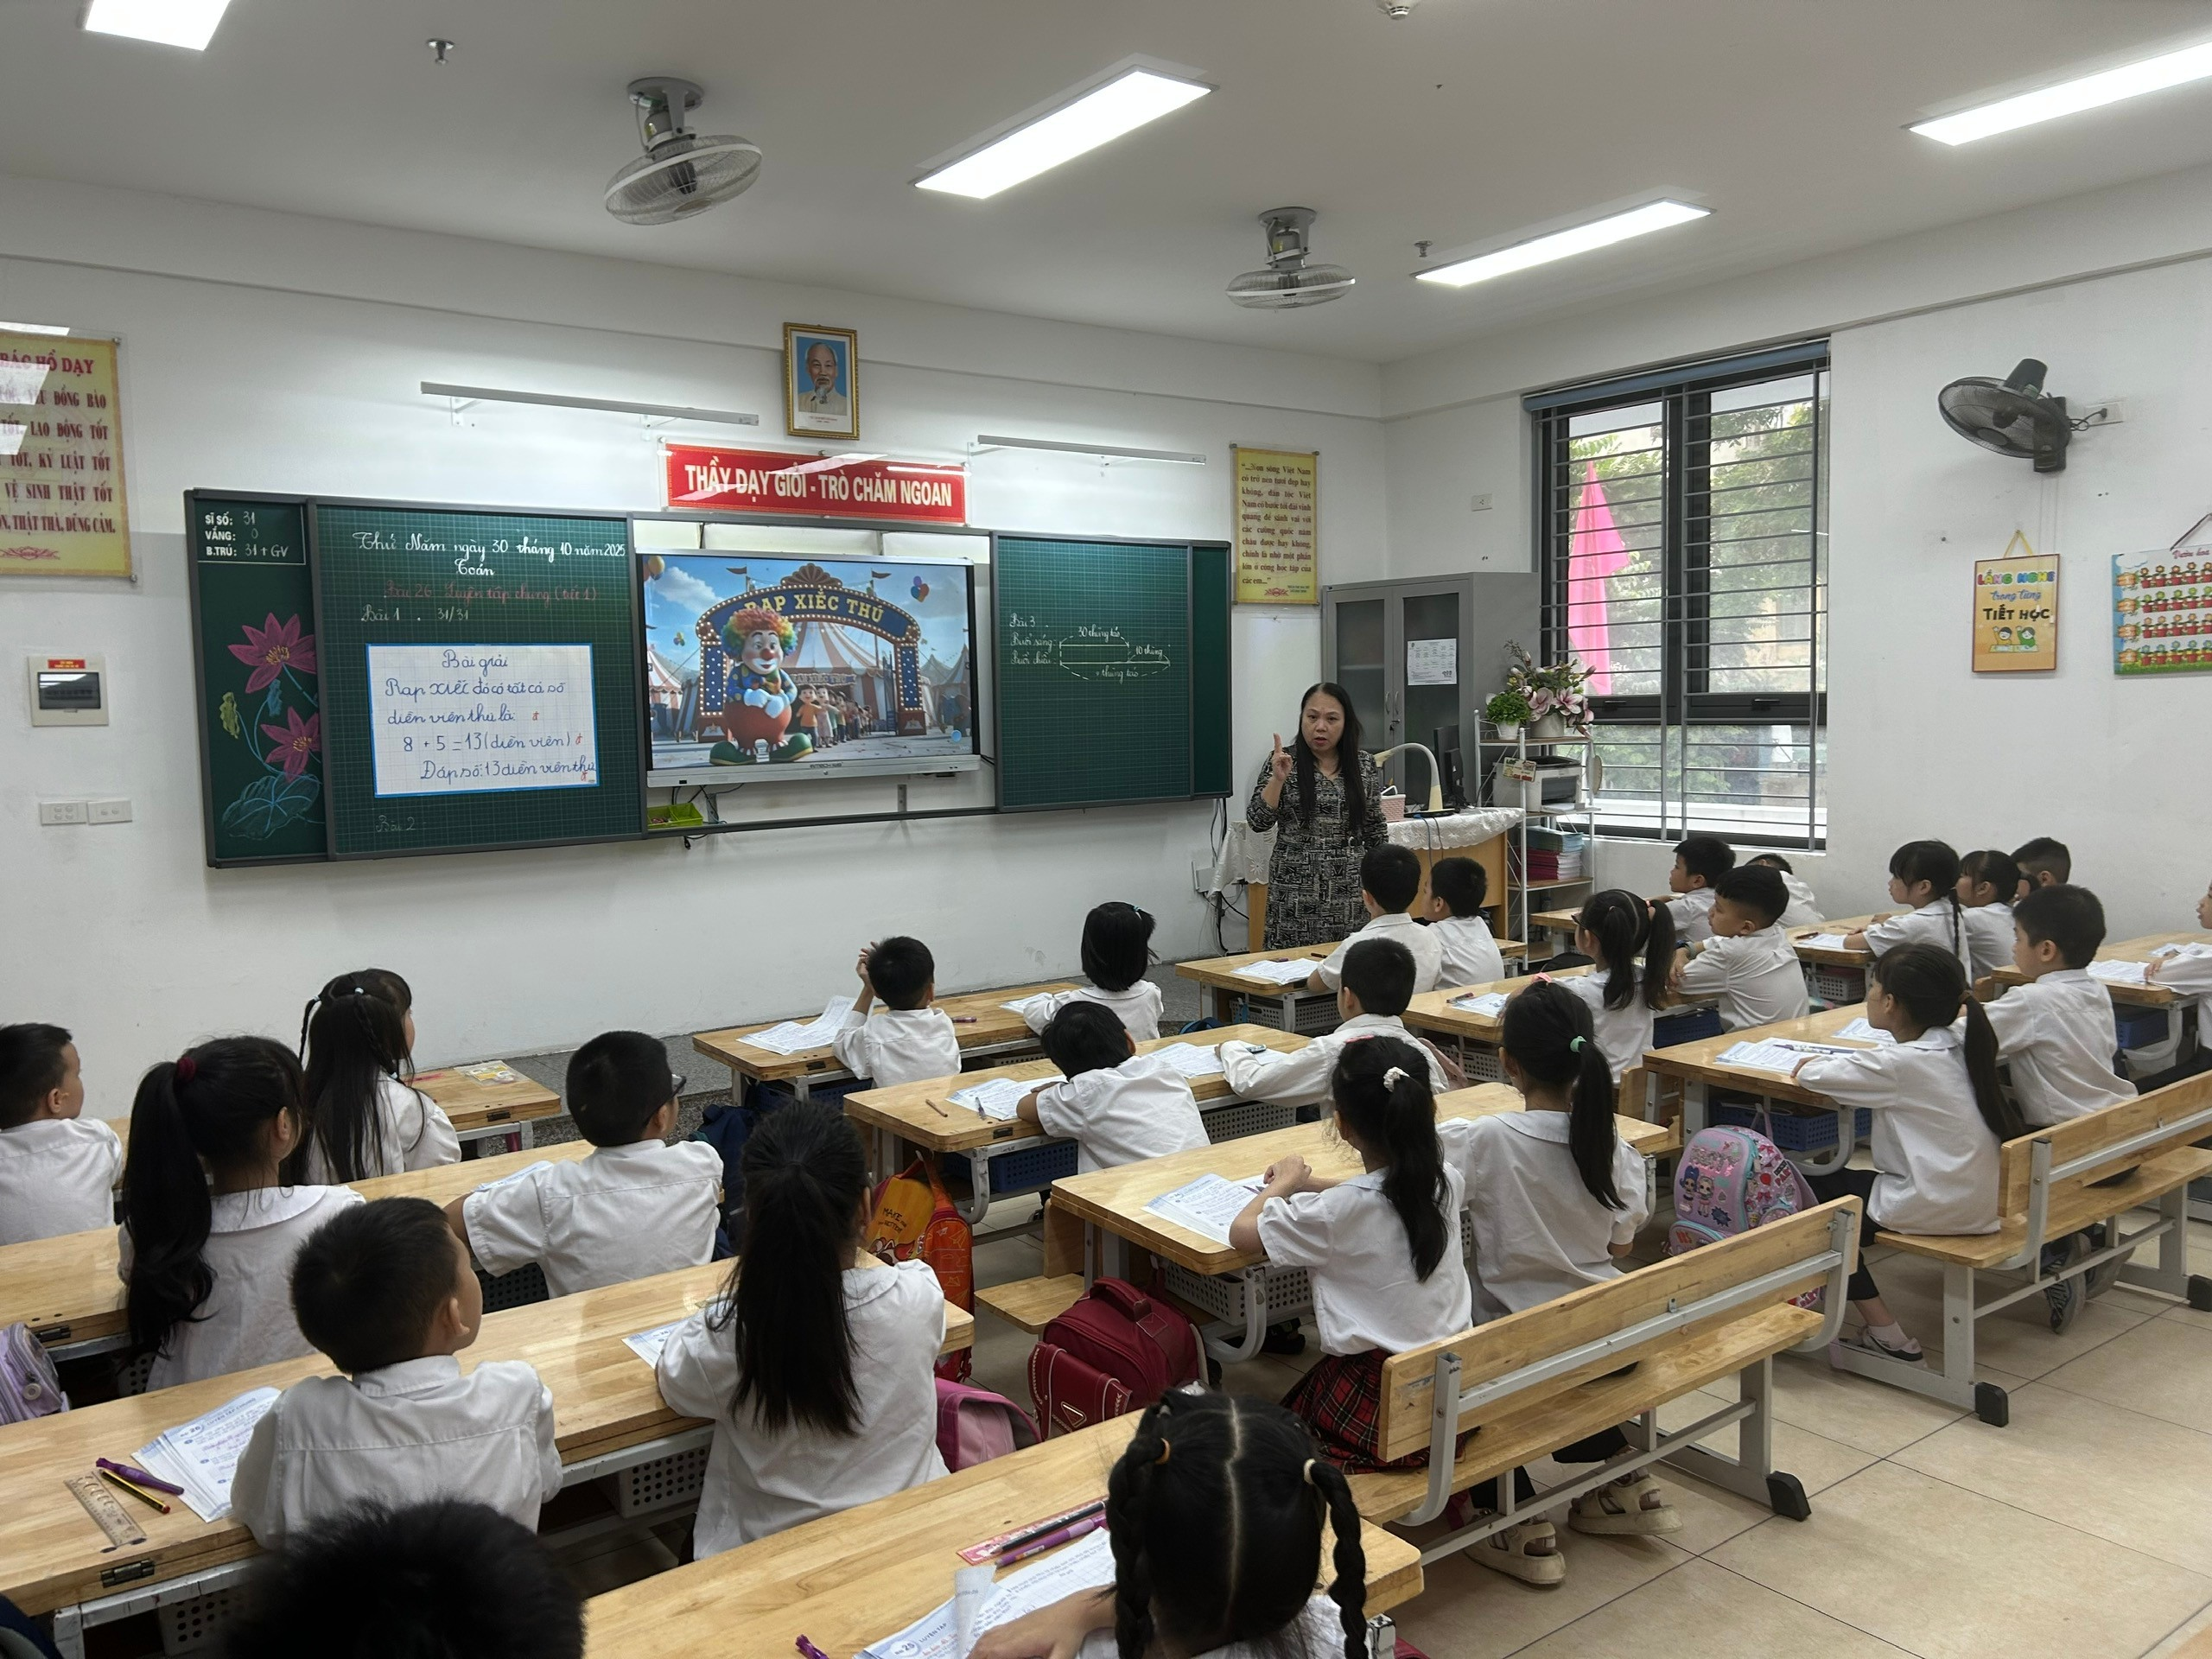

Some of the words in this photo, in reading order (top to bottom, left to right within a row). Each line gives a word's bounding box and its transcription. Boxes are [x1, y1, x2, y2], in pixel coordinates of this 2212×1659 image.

[61, 357, 94, 377] DẠY
[54, 384, 79, 406] ĐỒNG
[86, 389, 106, 409] BÀO
[30, 421, 50, 437] LAO
[57, 417, 83, 442] ĐỘNG
[90, 418, 108, 440] TỐT
[60, 450, 85, 474] LUẬT
[92, 449, 111, 471] TỐT
[684, 455, 731, 493] THẦY
[735, 468, 771, 502] DẠY
[774, 461, 807, 498] GIỎI
[817, 469, 849, 499] TRÒ
[853, 472, 896, 504] CHĂM
[900, 480, 952, 507] NGOAN
[5, 479, 18, 503] VỆ
[26, 483, 51, 499] SINH
[58, 482, 85, 505] THẬT
[92, 480, 112, 502] TỐT
[12, 511, 39, 536] THẬT
[216, 512, 233, 526] SỐ:
[243, 511, 255, 525] 31
[205, 525, 236, 541] VẮNG:
[206, 544, 237, 556] B.TRÚ:
[245, 543, 257, 556] 31
[270, 544, 289, 557] GV
[352, 531, 397, 550] Thứ
[405, 533, 446, 551] Năm
[454, 538, 486, 562] ngày
[492, 539, 508, 553] 30
[516, 536, 555, 563] tháng
[560, 542, 572, 556] 10
[575, 544, 603, 556] năm
[604, 543, 626, 556] 2025
[454, 558, 495, 575] Toán
[1978, 569, 2012, 586] LẮNG
[2017, 571, 2056, 584] NGHE
[394, 607, 400, 621] 1
[437, 606, 469, 622] 31/31
[794, 588, 839, 611] XIẾC
[846, 596, 884, 623] THÚ
[1982, 604, 2015, 620] TIẾT
[2019, 608, 2050, 622] HỌC
[1030, 615, 1036, 627] 3
[1136, 645, 1143, 655] 10
[442, 649, 475, 668] Bài
[479, 654, 508, 677] giải
[429, 680, 469, 695] xiếc
[473, 677, 489, 695] đó
[491, 682, 504, 695] có
[507, 681, 526, 694] tất
[547, 682, 566, 694] số
[388, 709, 426, 725] diễn
[429, 711, 466, 724] viên
[497, 702, 516, 721] là:
[404, 736, 413, 752] 8
[436, 735, 446, 751] 5
[452, 741, 462, 751] =
[465, 732, 482, 750] 13
[529, 731, 570, 747] viên)
[420, 760, 458, 785] Đáp
[486, 760, 501, 776] 13
[501, 760, 537, 776] diễn
[539, 761, 572, 772] viên
[406, 816, 416, 830] 2
